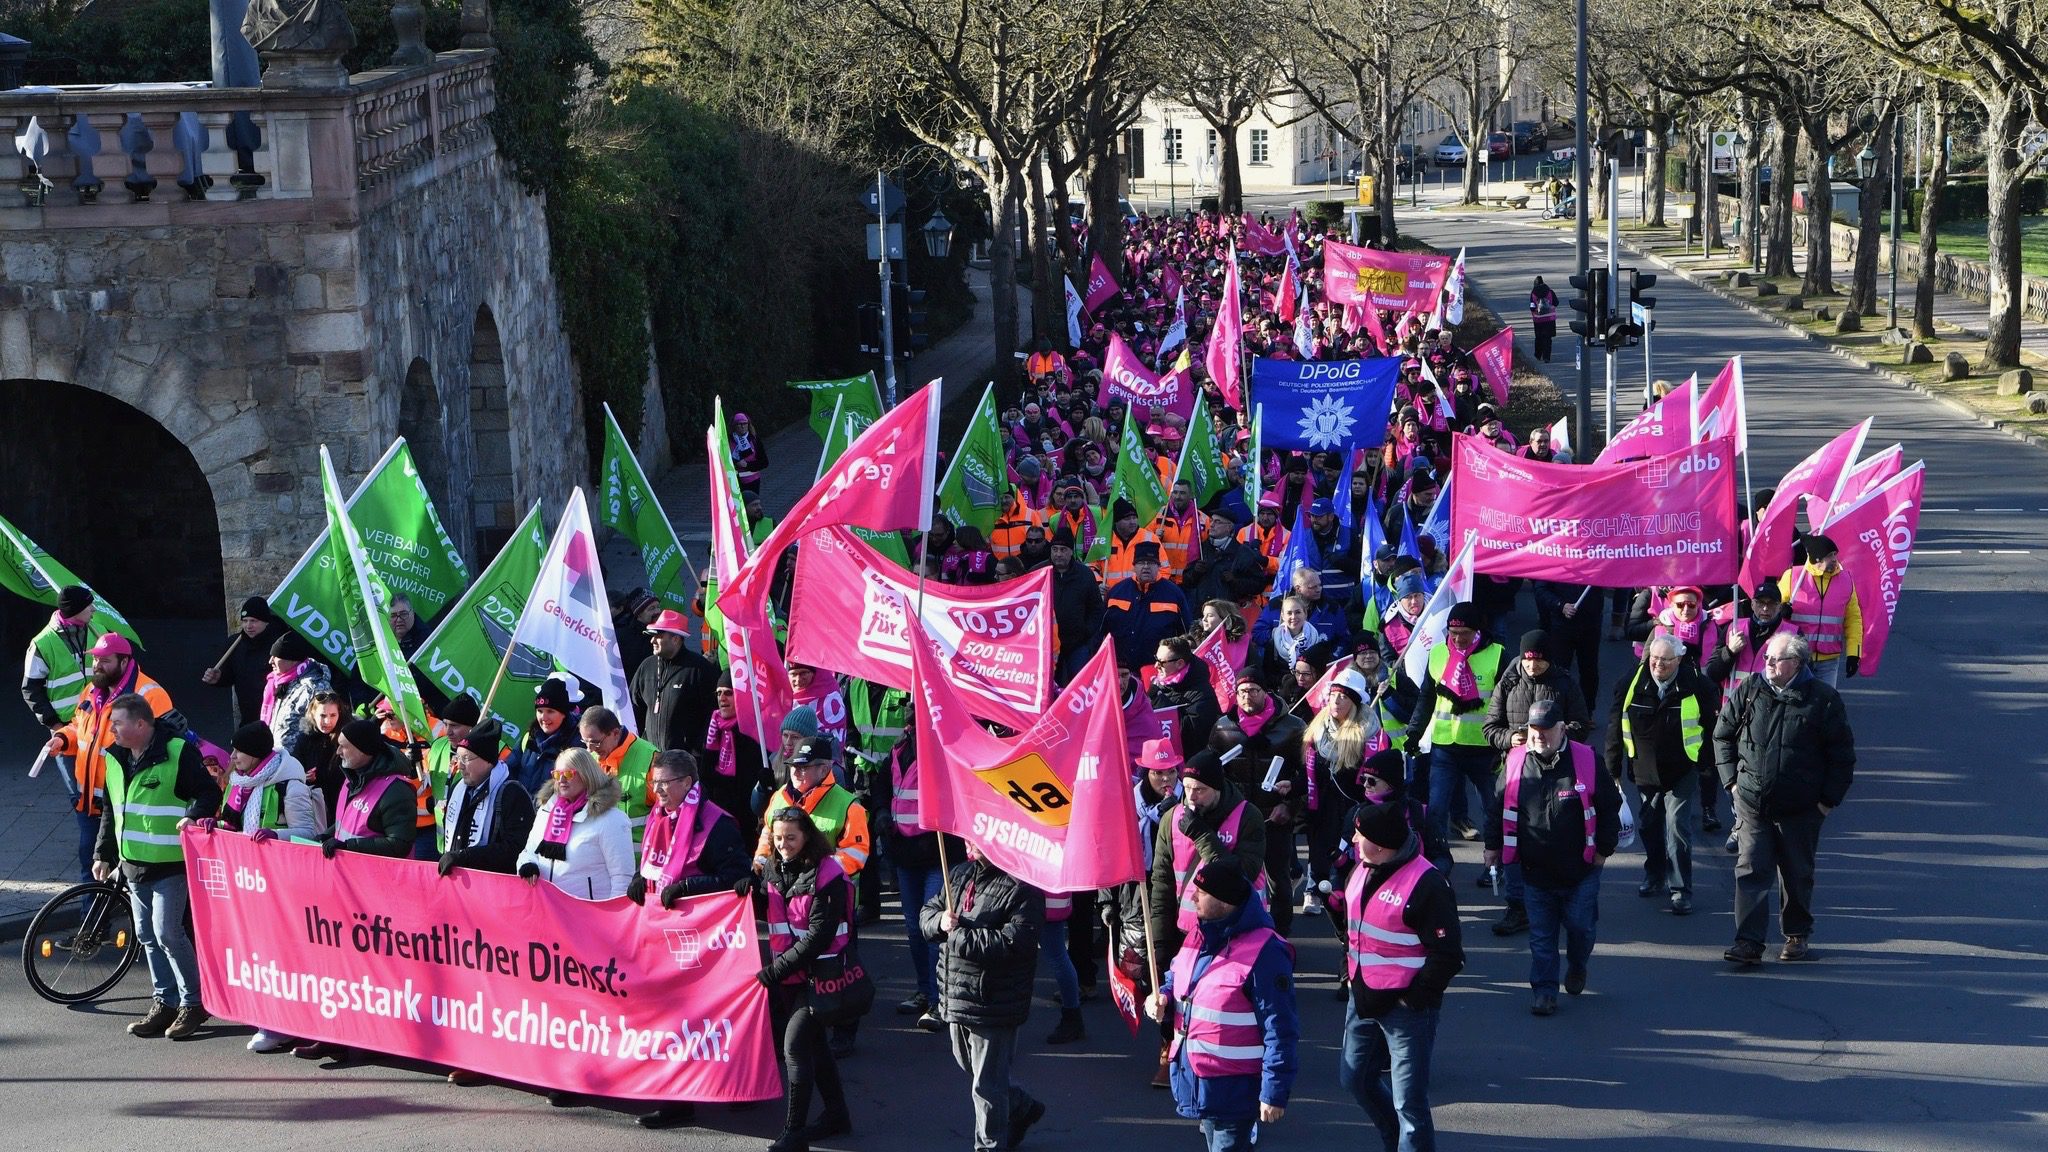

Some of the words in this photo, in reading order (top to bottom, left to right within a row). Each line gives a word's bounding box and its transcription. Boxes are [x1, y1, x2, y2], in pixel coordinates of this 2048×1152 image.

[1347, 251, 1362, 260] dbb
[1409, 280, 1424, 288] sind
[1278, 381, 1310, 389] DEUTSCHE
[1311, 378, 1377, 388] POLIZEIGEWERKSCHAFT
[1299, 362, 1361, 380] DPolG
[1108, 383, 1178, 407] gewerkschaft
[1679, 453, 1720, 474] dbb
[1480, 506, 1526, 534] MEHR
[1528, 511, 1701, 538] WERTSCHÄTZUNG
[365, 527, 430, 559] VERBAND
[1482, 537, 1523, 550] unsere
[1526, 540, 1562, 557] Arbeit
[1565, 545, 1583, 558] im
[1586, 543, 1673, 559] öffentlichen
[1676, 539, 1722, 553] Dienst
[365, 547, 431, 580] EUTSCHER
[865, 611, 897, 635] für
[963, 640, 993, 658] 500
[995, 646, 1024, 664] Euro
[957, 659, 1036, 686] mindestens
[428, 646, 521, 738] VDSra
[1077, 751, 1100, 781] ir
[1154, 751, 1169, 760] dbb
[352, 798, 371, 814] dbb
[1007, 780, 1070, 813] da
[552, 806, 566, 837] dbb
[234, 865, 267, 893] dbb
[1379, 889, 1403, 906] dbb
[706, 923, 747, 951] dbb
[305, 905, 343, 948] Ihr
[352, 912, 519, 978] öffentlicher
[528, 941, 628, 998] Dienst:
[225, 948, 421, 1023] Leistungsstark
[431, 992, 484, 1034] und
[492, 999, 612, 1057] schlecht
[617, 1015, 734, 1063] bezahlt!
